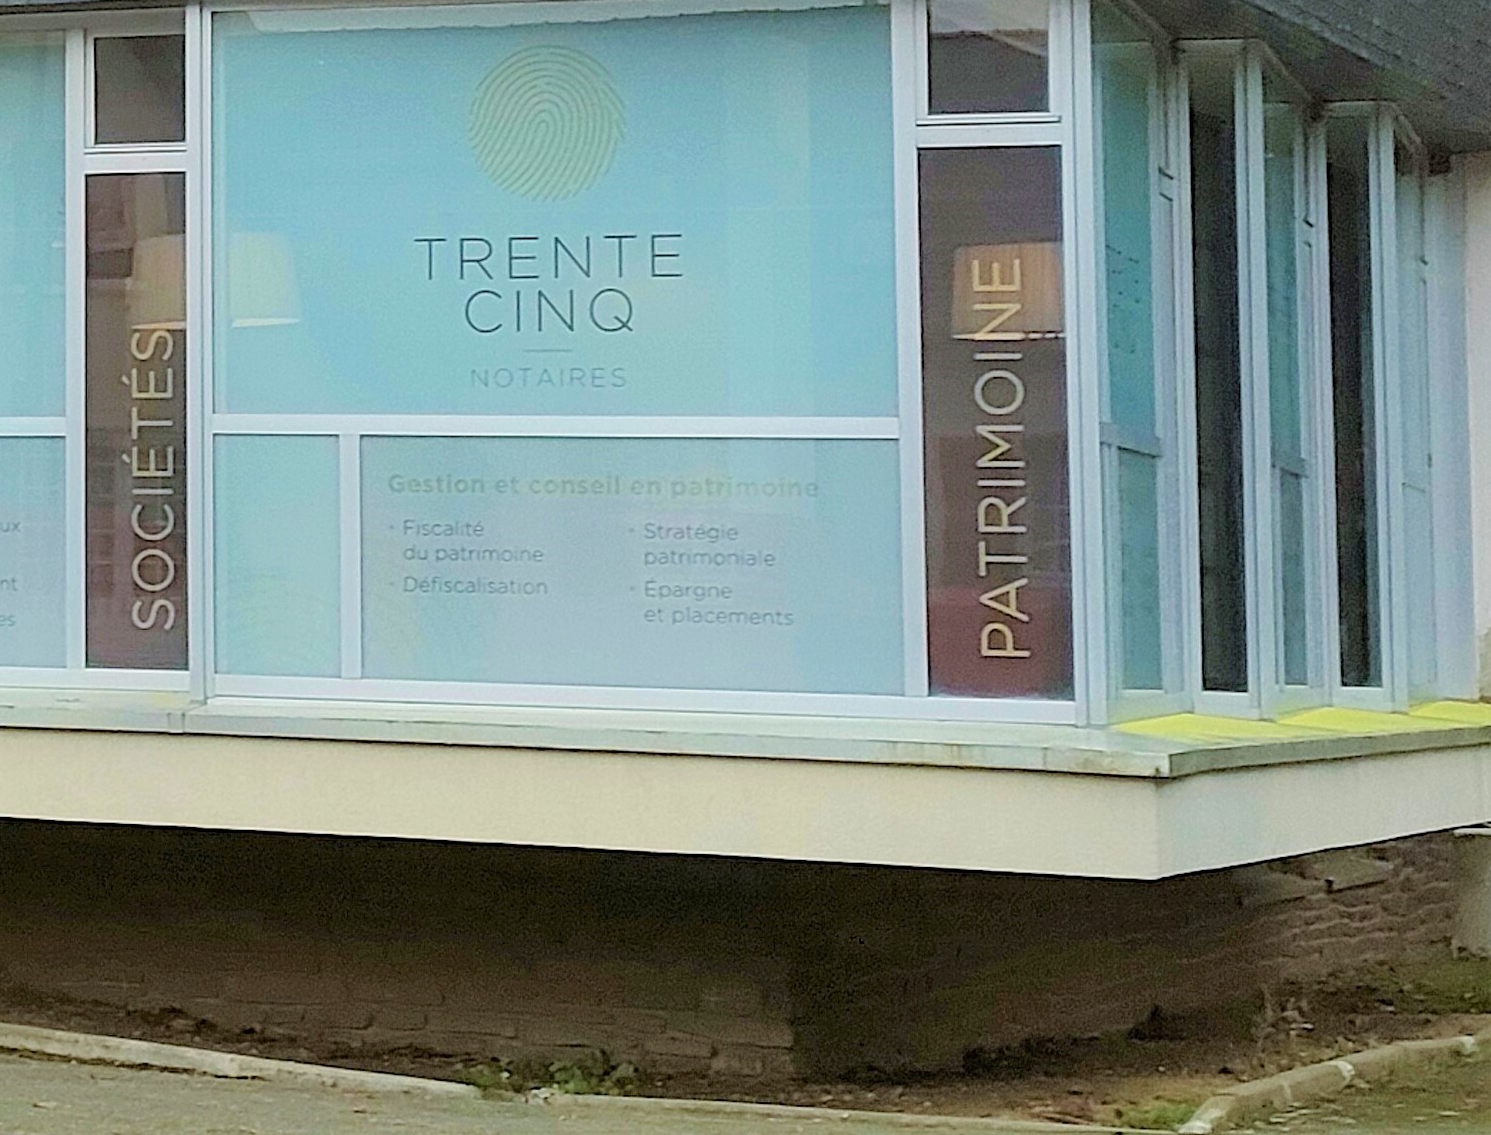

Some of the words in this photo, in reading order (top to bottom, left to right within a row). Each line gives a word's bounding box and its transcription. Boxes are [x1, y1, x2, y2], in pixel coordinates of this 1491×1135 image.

[414, 234, 683, 281] TRENTE
[464, 289, 635, 334] CINQ
[470, 367, 627, 389] NOTAIRES
[973, 258, 1032, 659] PATRIMOINE
[122, 327, 175, 631] SOCIÉTÉS
[388, 474, 485, 493] Gestion
[495, 476, 520, 494] et
[529, 475, 620, 495] conseil
[630, 480, 662, 496] en
[671, 476, 819, 498] patrimoine
[403, 519, 485, 537] Fiscalité
[644, 522, 739, 543] Stratégie
[403, 545, 428, 561] du
[435, 546, 545, 563] patrimoine
[644, 550, 776, 567] patrimoniale
[403, 576, 548, 595] Défiscalisation
[644, 577, 733, 601] Épargne
[644, 608, 664, 623] et
[672, 607, 794, 626] placements
